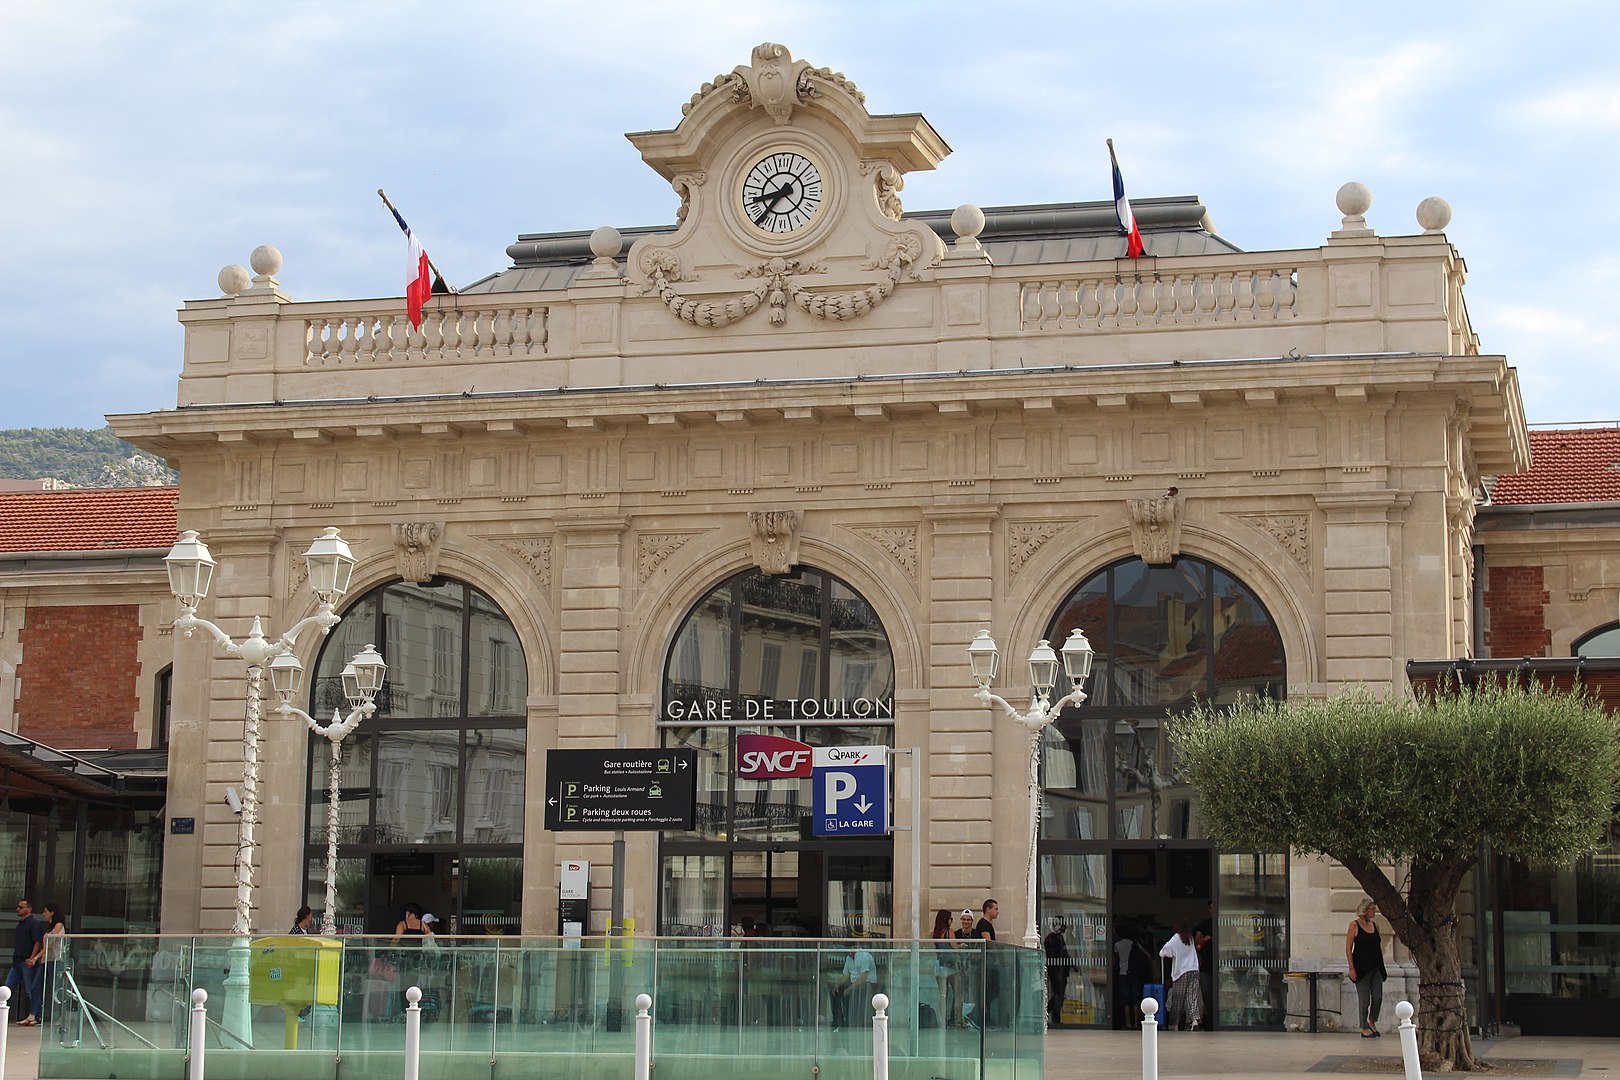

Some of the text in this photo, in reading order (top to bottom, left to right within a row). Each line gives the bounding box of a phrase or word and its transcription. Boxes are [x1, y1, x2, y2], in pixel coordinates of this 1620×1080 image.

[667, 697, 893, 719] GARE DE TOULON
[603, 760, 653, 768] Gare routière
[740, 750, 811, 773] SNCF
[568, 784, 577, 796] P
[583, 784, 611, 794] Parking
[825, 771, 858, 815] P
[567, 808, 576, 820] P
[582, 808, 610, 818] Parking
[611, 808, 630, 816] deux
[852, 820, 874, 828] GARE
